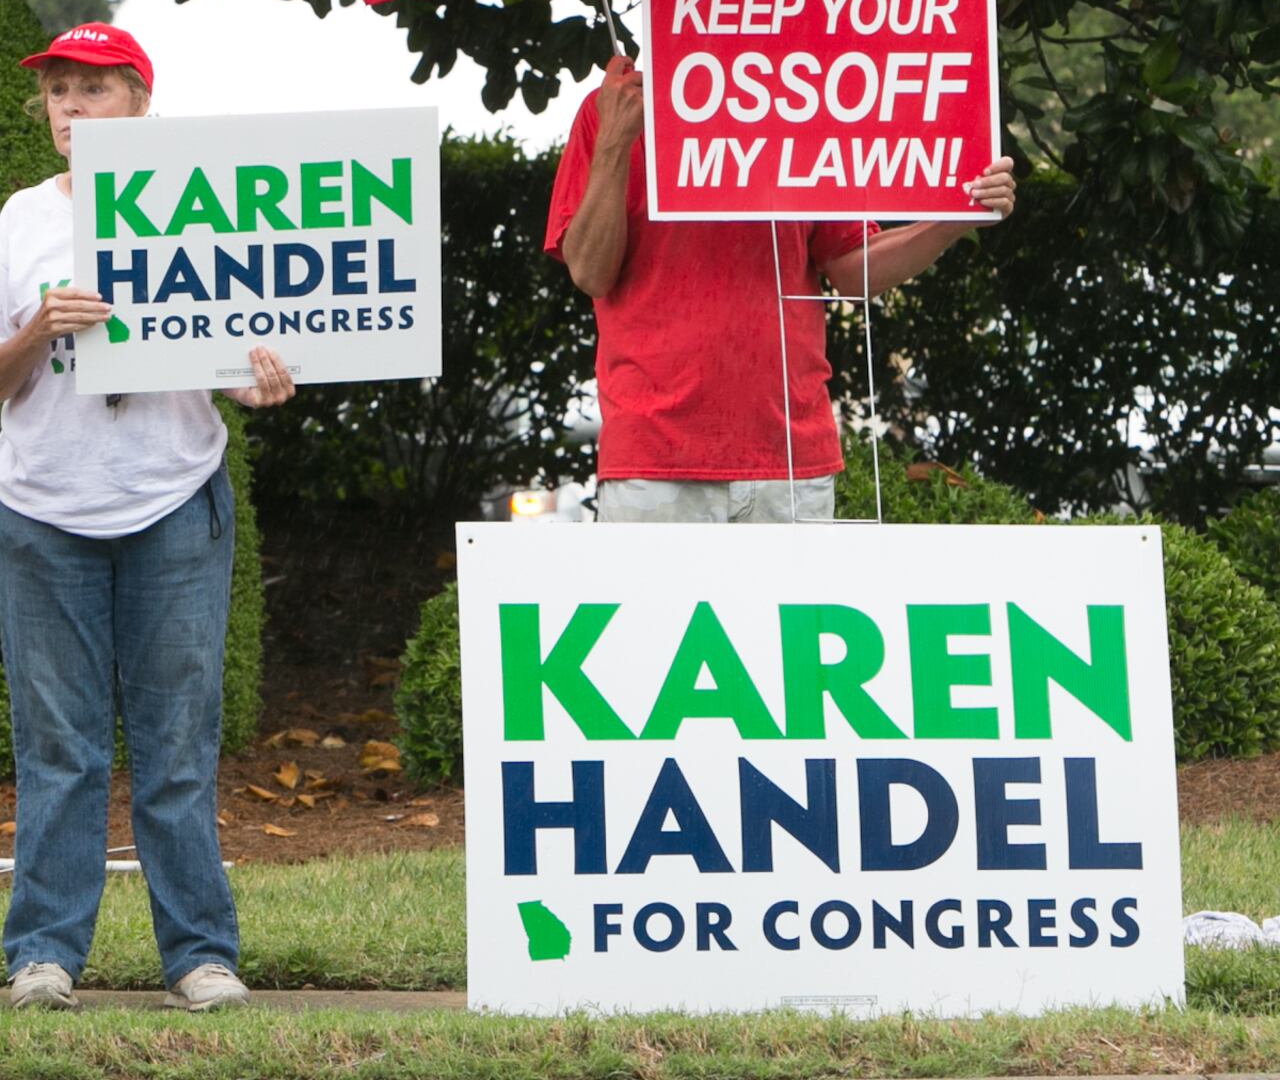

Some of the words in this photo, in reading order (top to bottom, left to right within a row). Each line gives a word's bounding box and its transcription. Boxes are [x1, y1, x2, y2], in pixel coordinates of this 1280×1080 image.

[670, 51, 972, 123] OSSOFF
[677, 137, 767, 188] MY
[777, 137, 963, 188] LAWN!
[94, 157, 414, 240] KAREN
[96, 239, 417, 305] HANDEL
[141, 315, 213, 341] FOR
[224, 304, 415, 337] CONGRESS
[498, 600, 1133, 743] KAREN
[501, 757, 1144, 876] HANDEL
[593, 902, 739, 953] FOR
[762, 897, 1140, 951] CONGRESS
